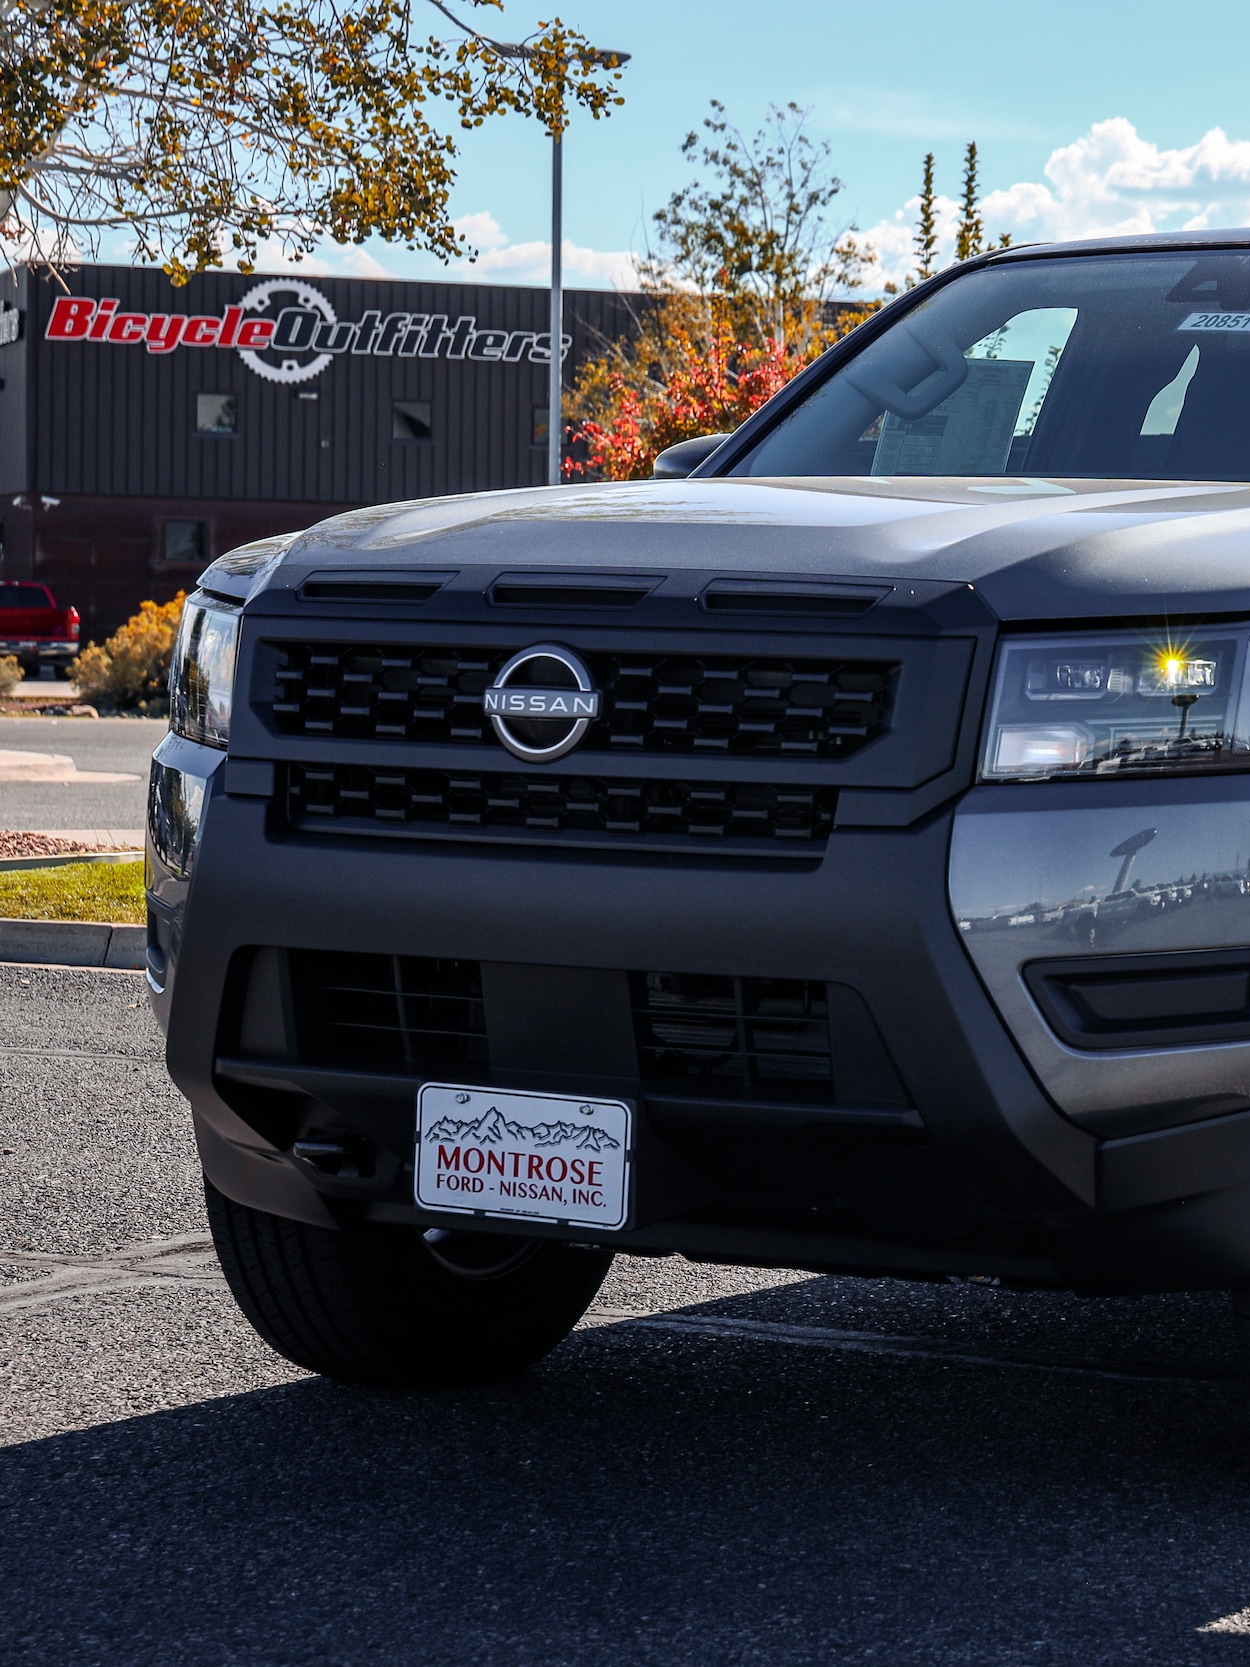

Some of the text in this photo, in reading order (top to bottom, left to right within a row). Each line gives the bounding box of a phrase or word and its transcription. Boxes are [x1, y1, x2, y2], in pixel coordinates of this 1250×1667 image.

[484, 693, 595, 713] NISSAN
[437, 1144, 604, 1187] MONTROSE
[436, 1173, 485, 1193] FORD
[499, 1180, 568, 1206] NISSAN,
[572, 1188, 607, 1208] INC.
